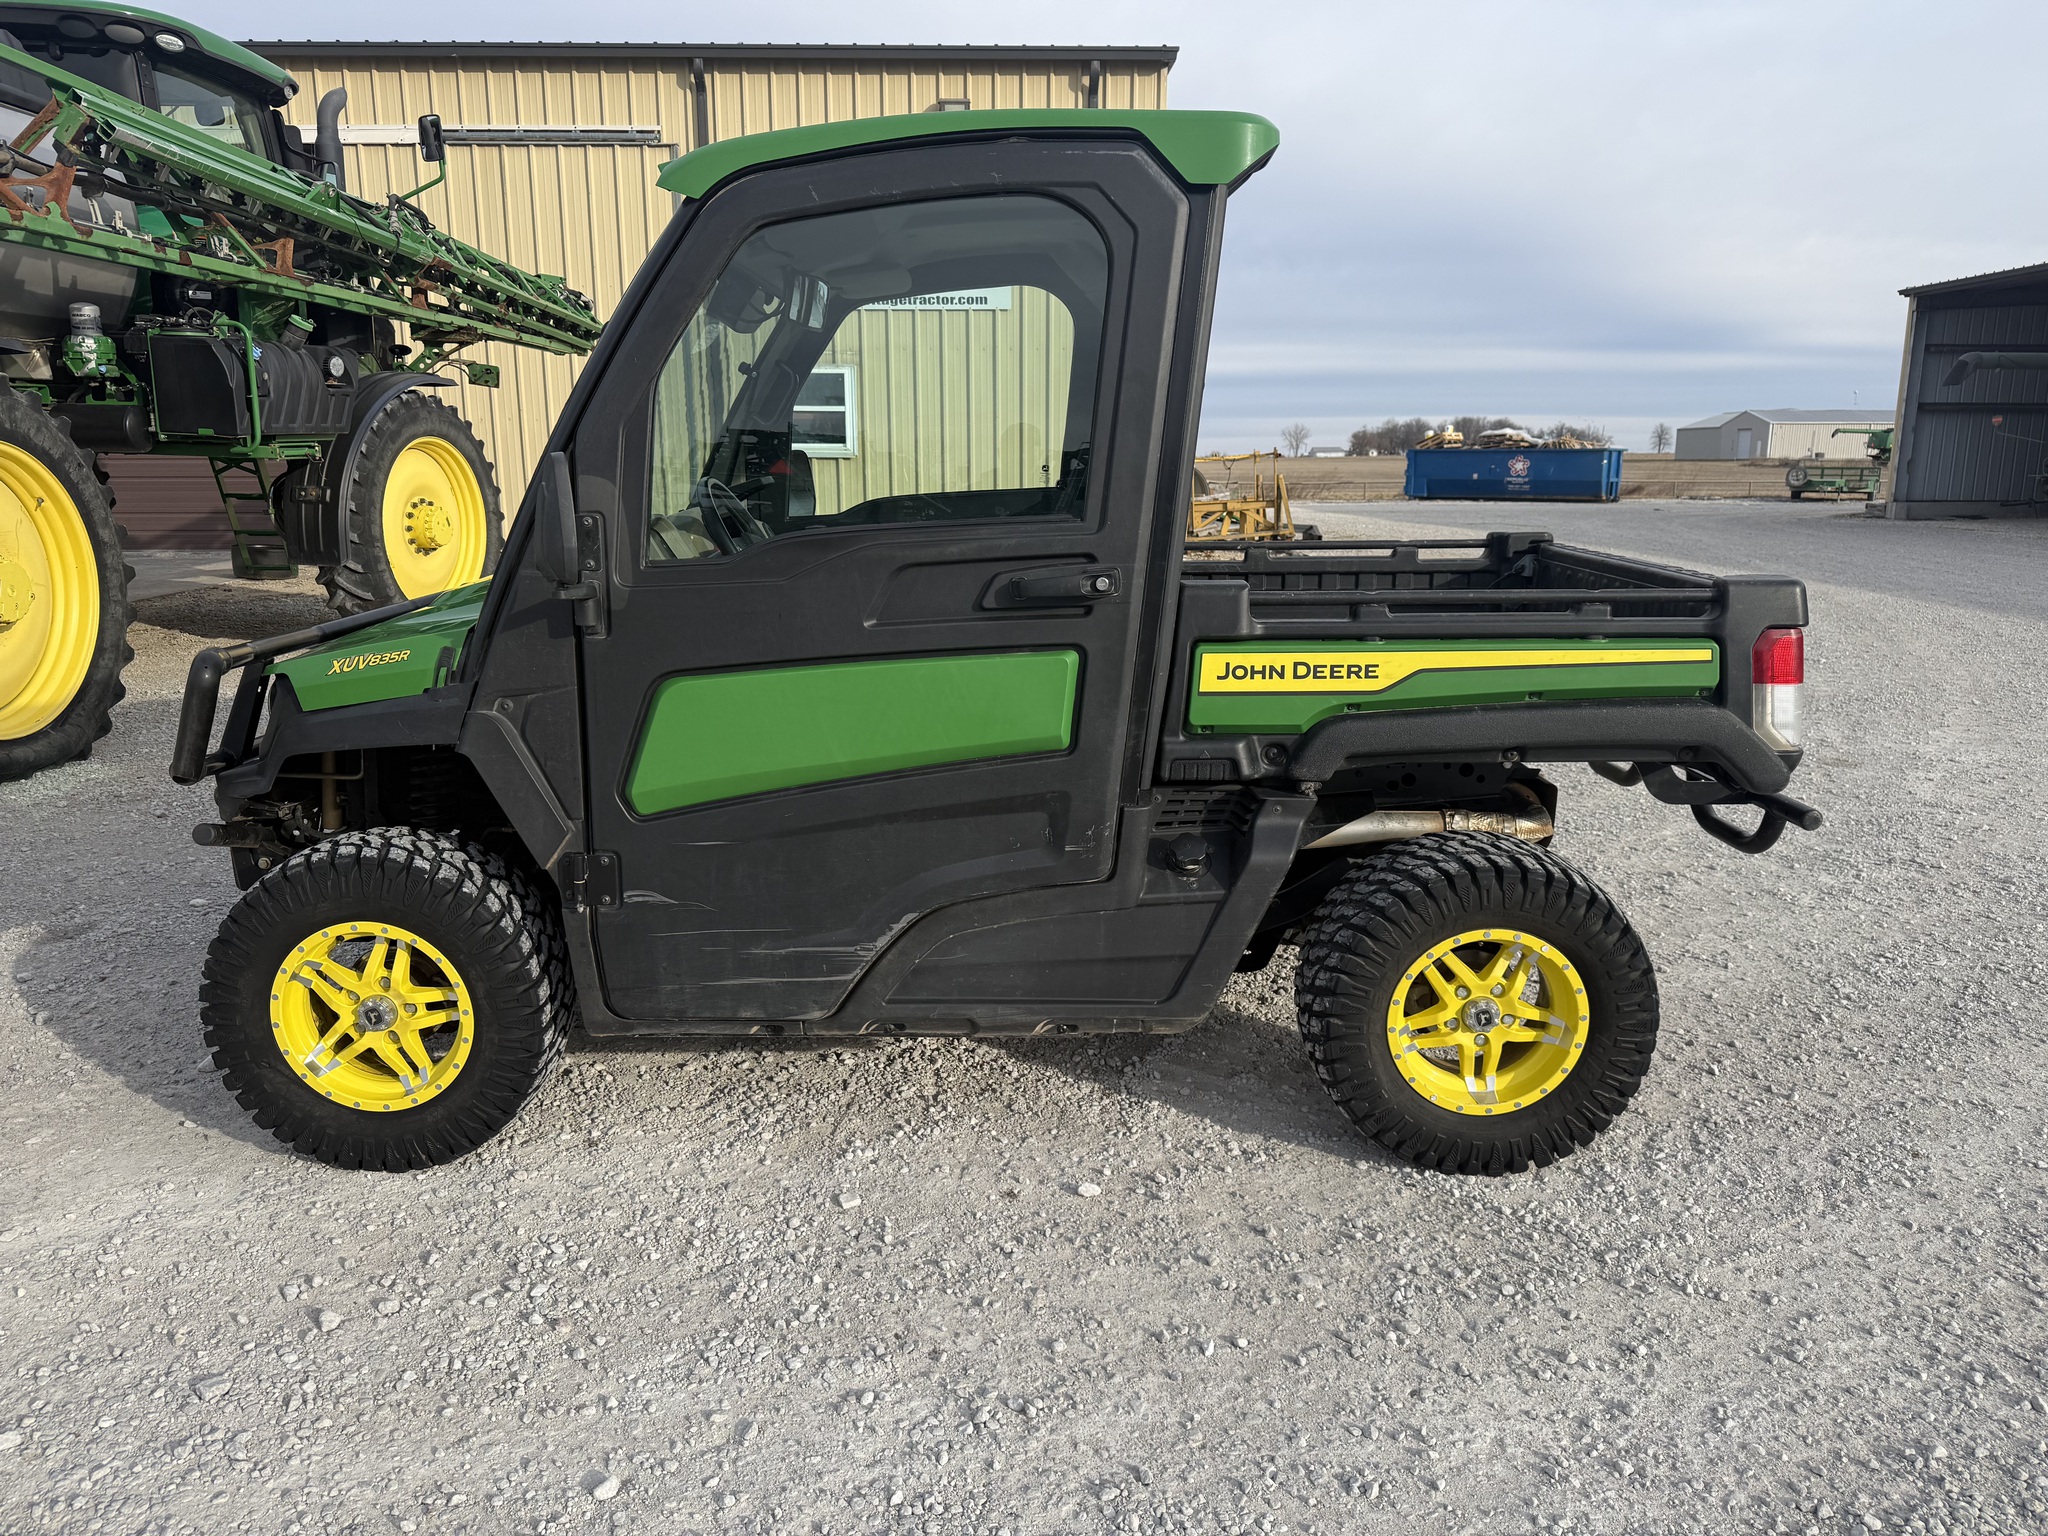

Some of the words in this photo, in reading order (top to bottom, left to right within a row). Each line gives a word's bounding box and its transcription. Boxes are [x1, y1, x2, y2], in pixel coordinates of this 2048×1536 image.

[325, 649, 411, 676] XUV835R
[1216, 662, 1286, 680] JOHN
[1293, 661, 1380, 680] DEERE
